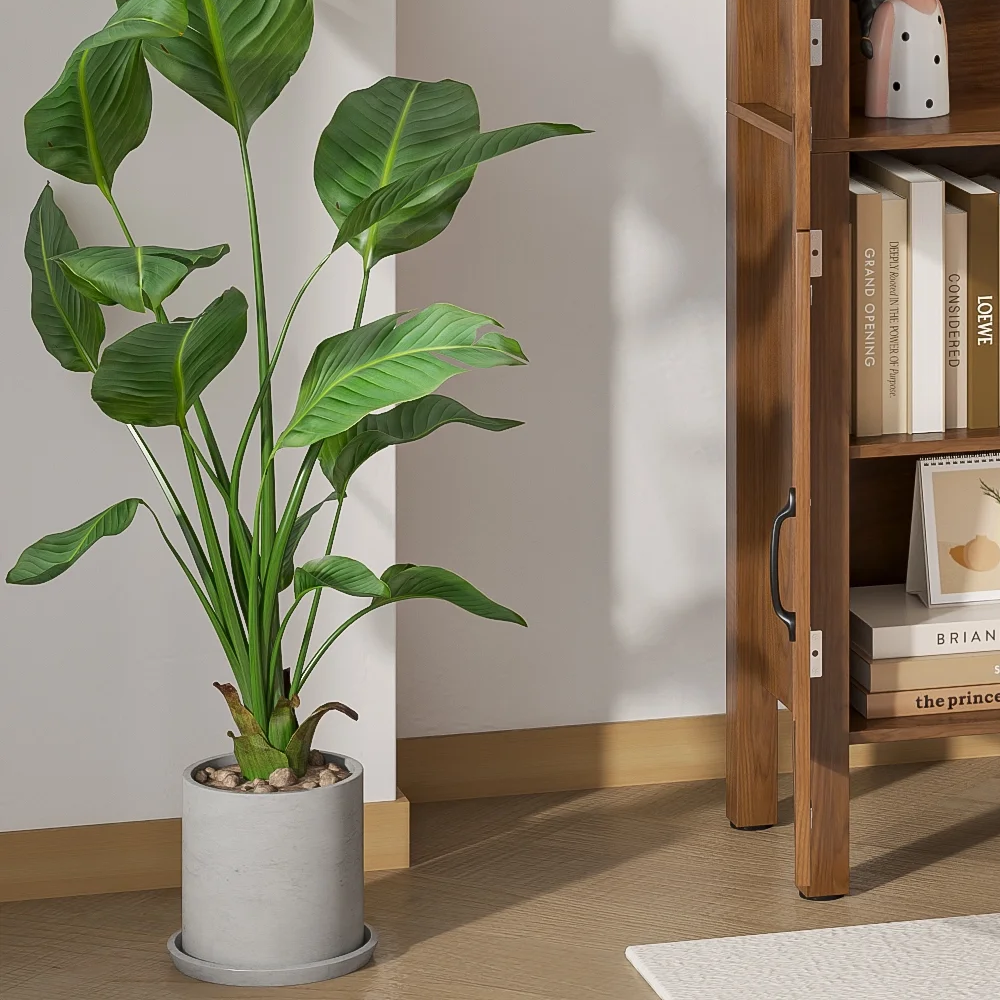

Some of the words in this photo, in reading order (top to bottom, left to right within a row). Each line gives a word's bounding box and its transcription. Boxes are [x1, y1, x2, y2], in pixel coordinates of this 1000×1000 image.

[889, 241, 899, 270] DEEPLY
[864, 248, 875, 297] GRAND
[889, 271, 899, 297] Rooted
[889, 297, 899, 306] IN
[889, 307, 899, 324] THE
[864, 303, 875, 367] OPENING
[948, 274, 961, 368] CONSIDERED
[977, 295, 993, 346] LOEWE
[889, 325, 899, 354] POWER
[889, 355, 899, 367] OF
[915, 694, 945, 709] the
